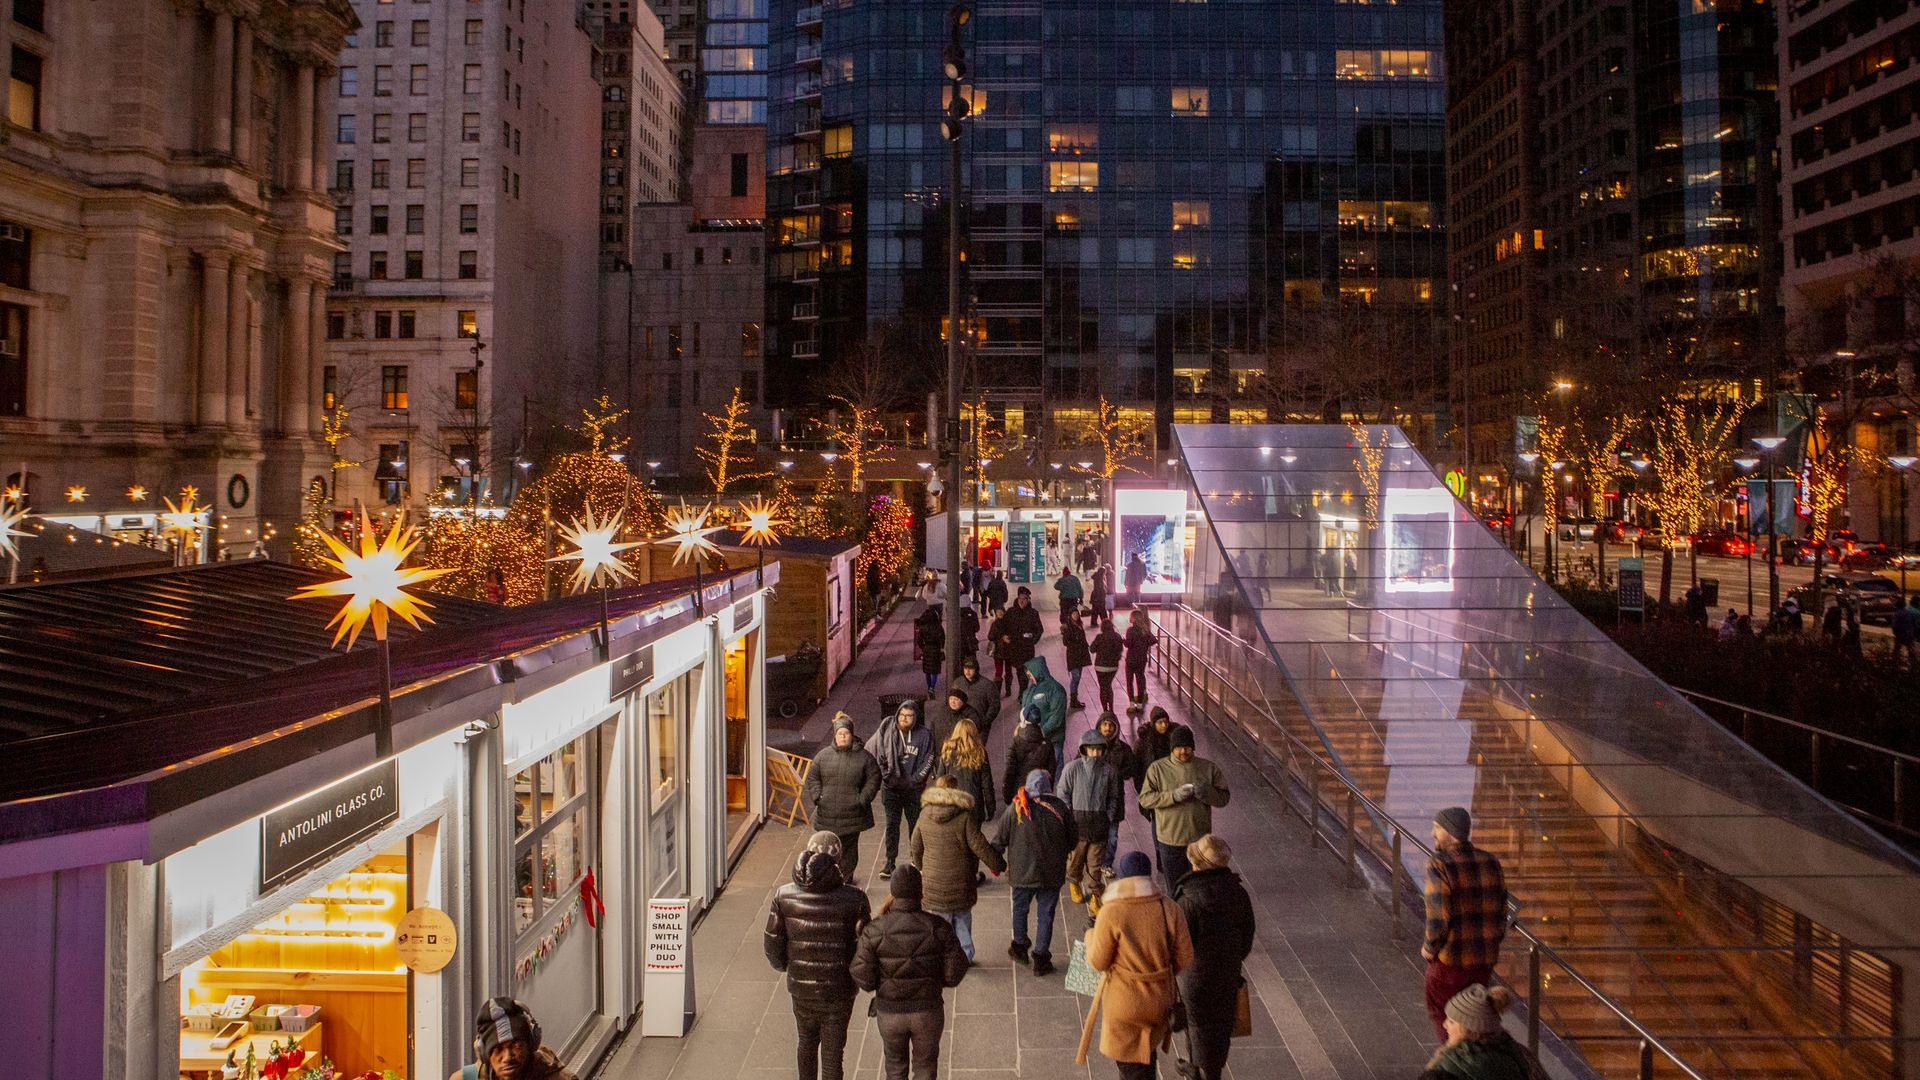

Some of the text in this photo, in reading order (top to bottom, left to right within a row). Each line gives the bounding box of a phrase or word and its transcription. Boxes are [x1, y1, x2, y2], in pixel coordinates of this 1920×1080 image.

[279, 785, 386, 848] ANTOLINI GLASS CO.
